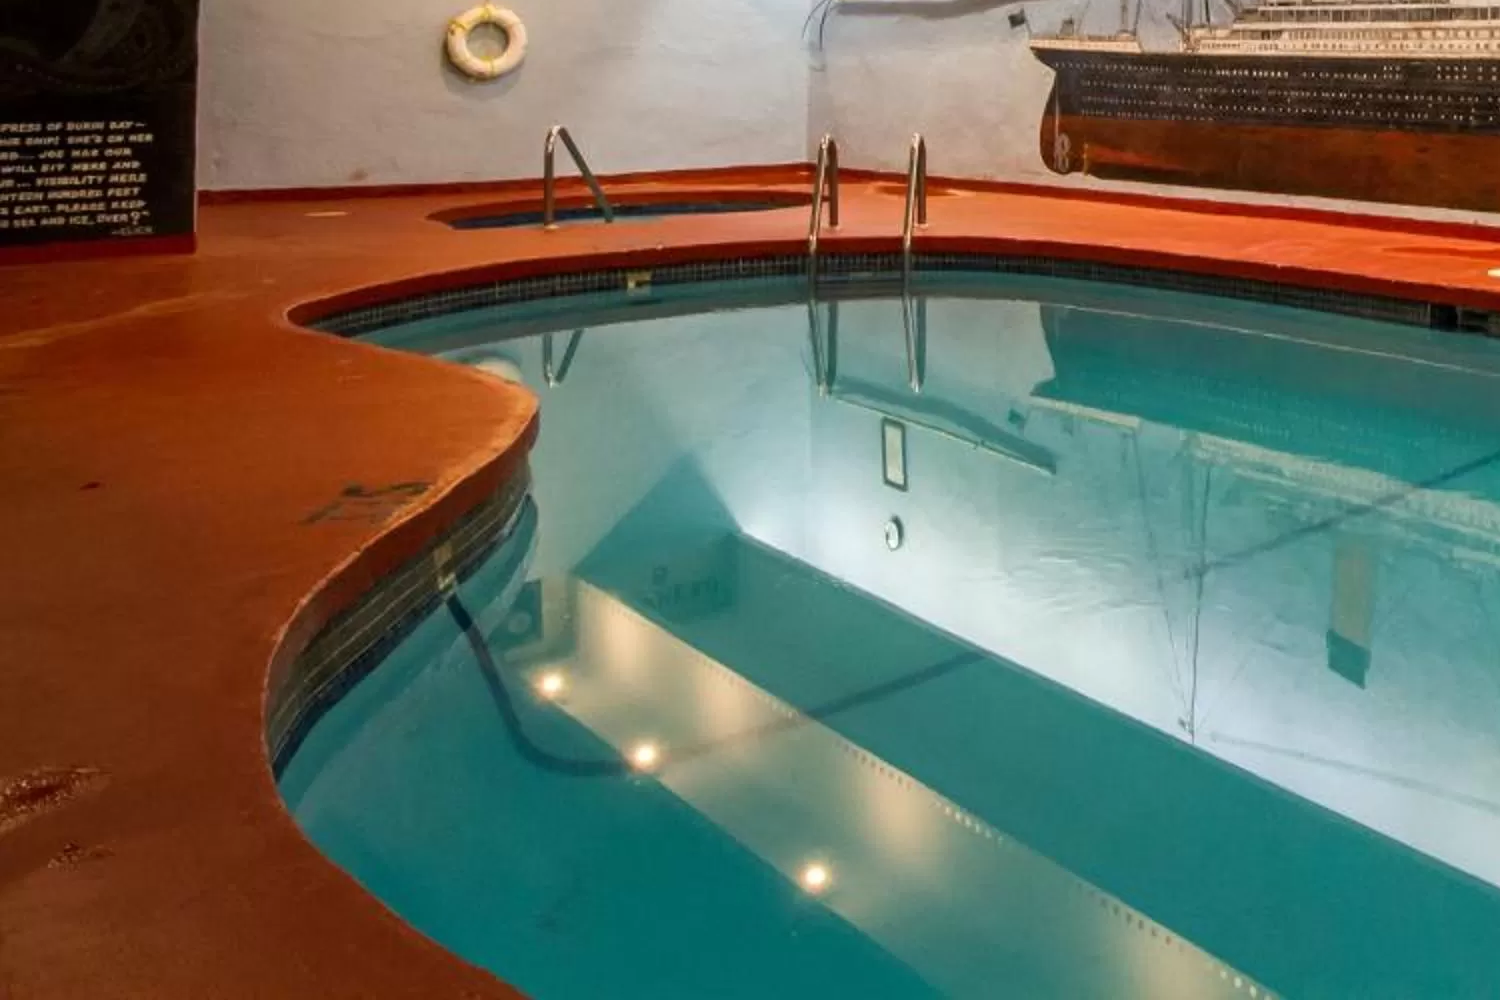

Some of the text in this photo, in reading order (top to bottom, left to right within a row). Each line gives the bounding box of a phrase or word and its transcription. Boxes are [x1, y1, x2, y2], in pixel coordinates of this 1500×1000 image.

[111, 160, 141, 170] AND
[36, 175, 105, 187] VISIBILITY
[55, 202, 107, 214] PLEASE
